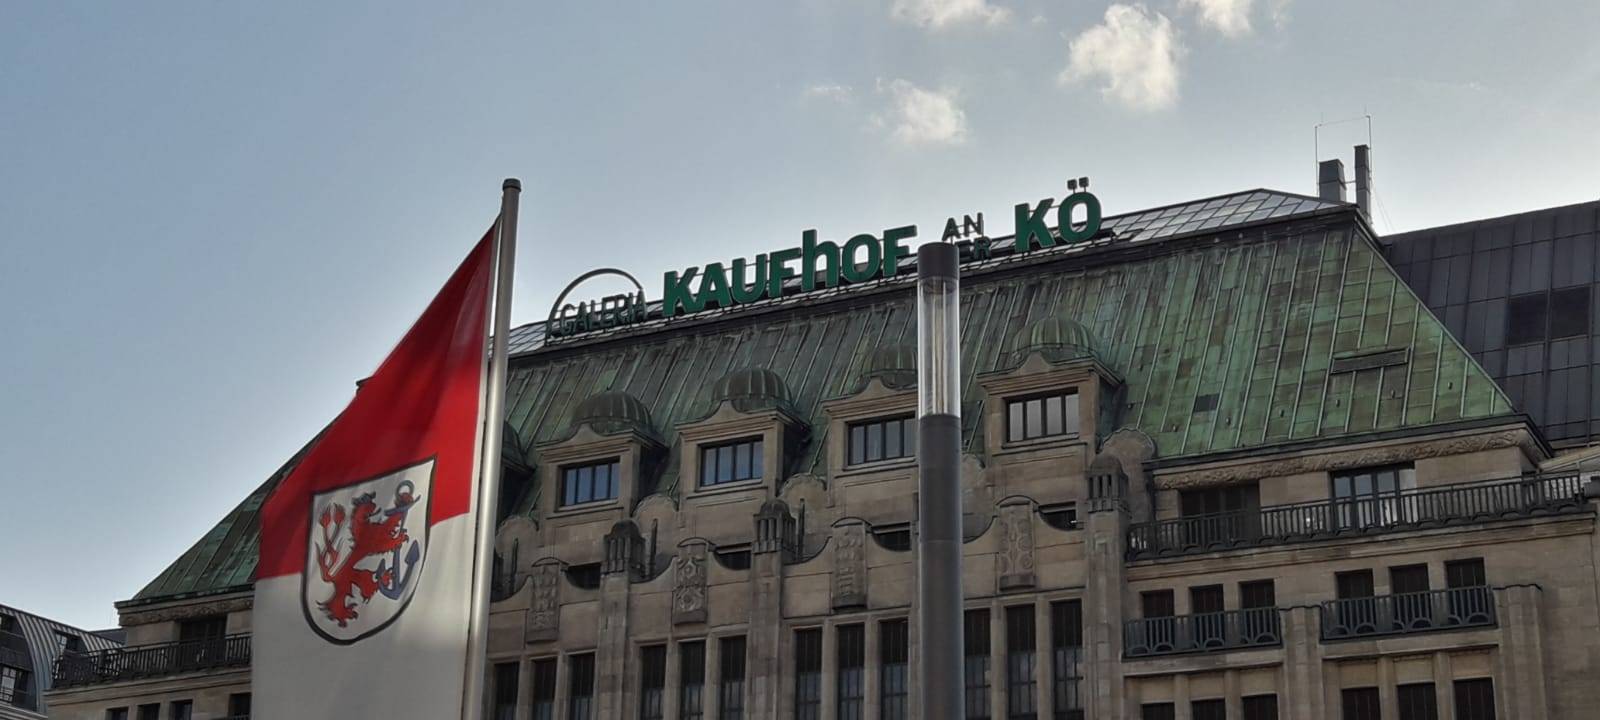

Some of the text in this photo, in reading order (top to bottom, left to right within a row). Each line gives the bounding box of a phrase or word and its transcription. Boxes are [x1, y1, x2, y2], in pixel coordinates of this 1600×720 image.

[942, 212, 984, 242] AN
[1014, 177, 1102, 252] KÖ
[953, 236, 992, 263] ER
[560, 288, 648, 336] GALERIA
